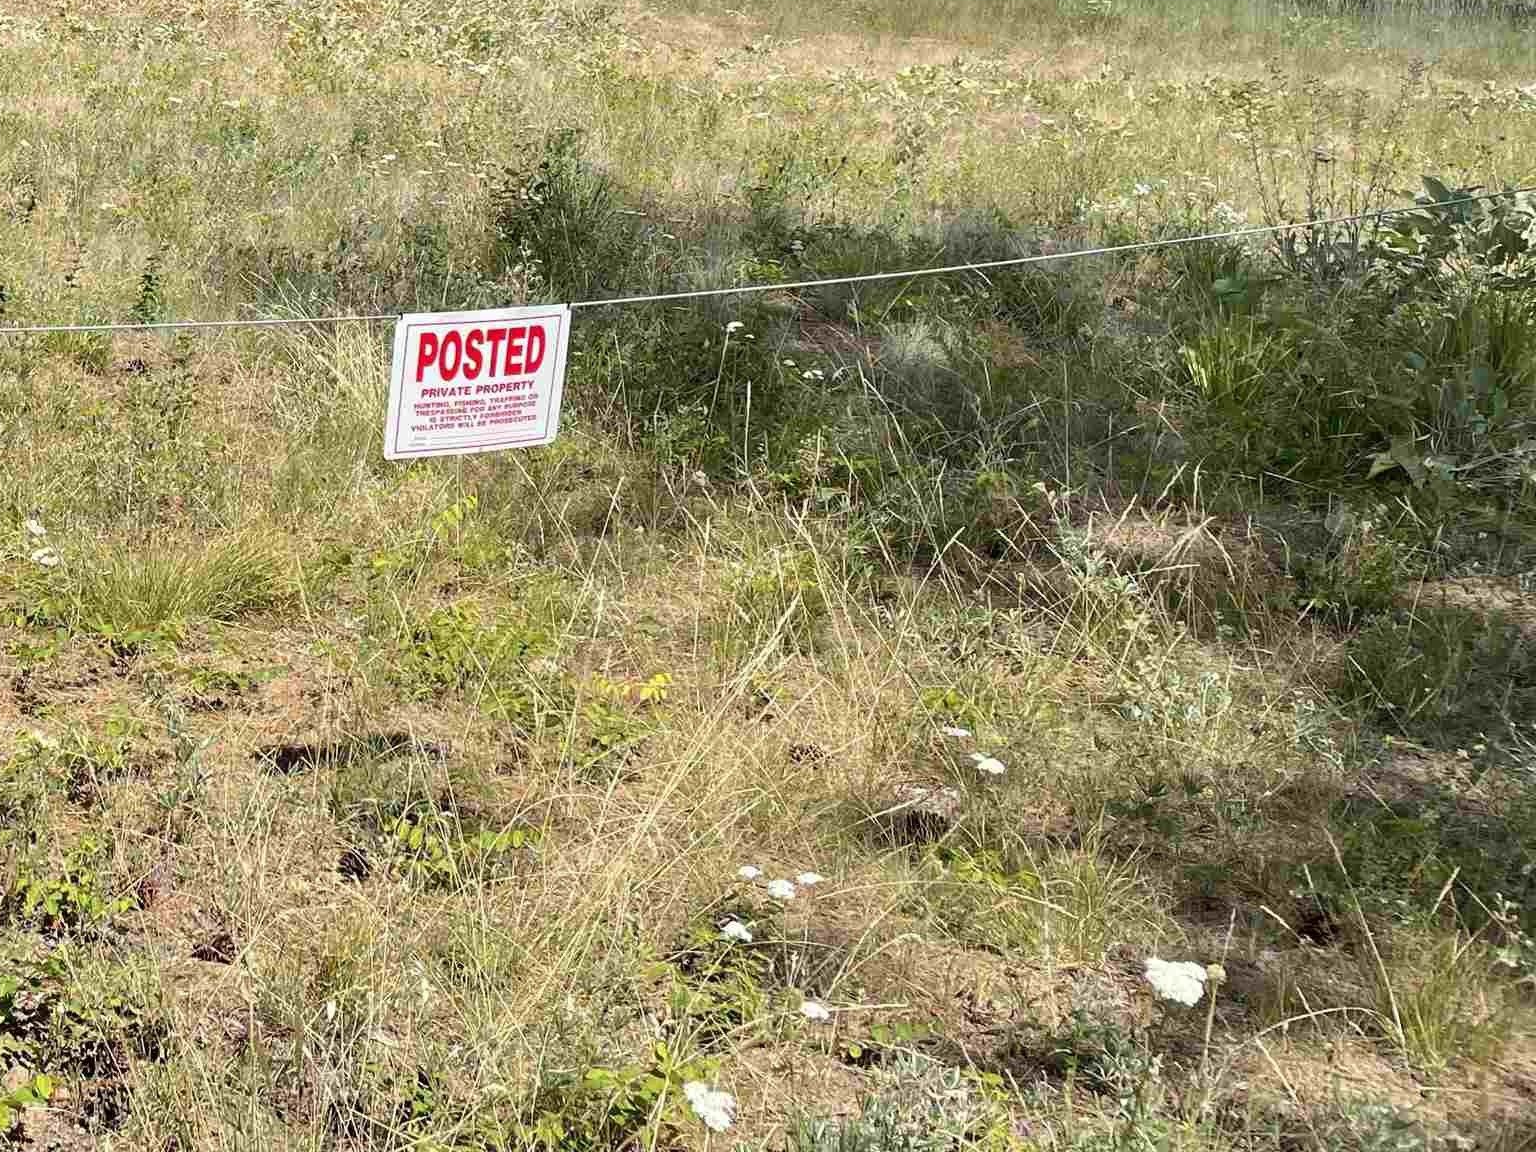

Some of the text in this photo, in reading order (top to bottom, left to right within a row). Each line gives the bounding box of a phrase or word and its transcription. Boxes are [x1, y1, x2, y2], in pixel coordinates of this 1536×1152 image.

[416, 325, 546, 382] POSTED
[421, 380, 535, 398] PRIVATE PROPERTY
[440, 414, 477, 423] STRICTLY
